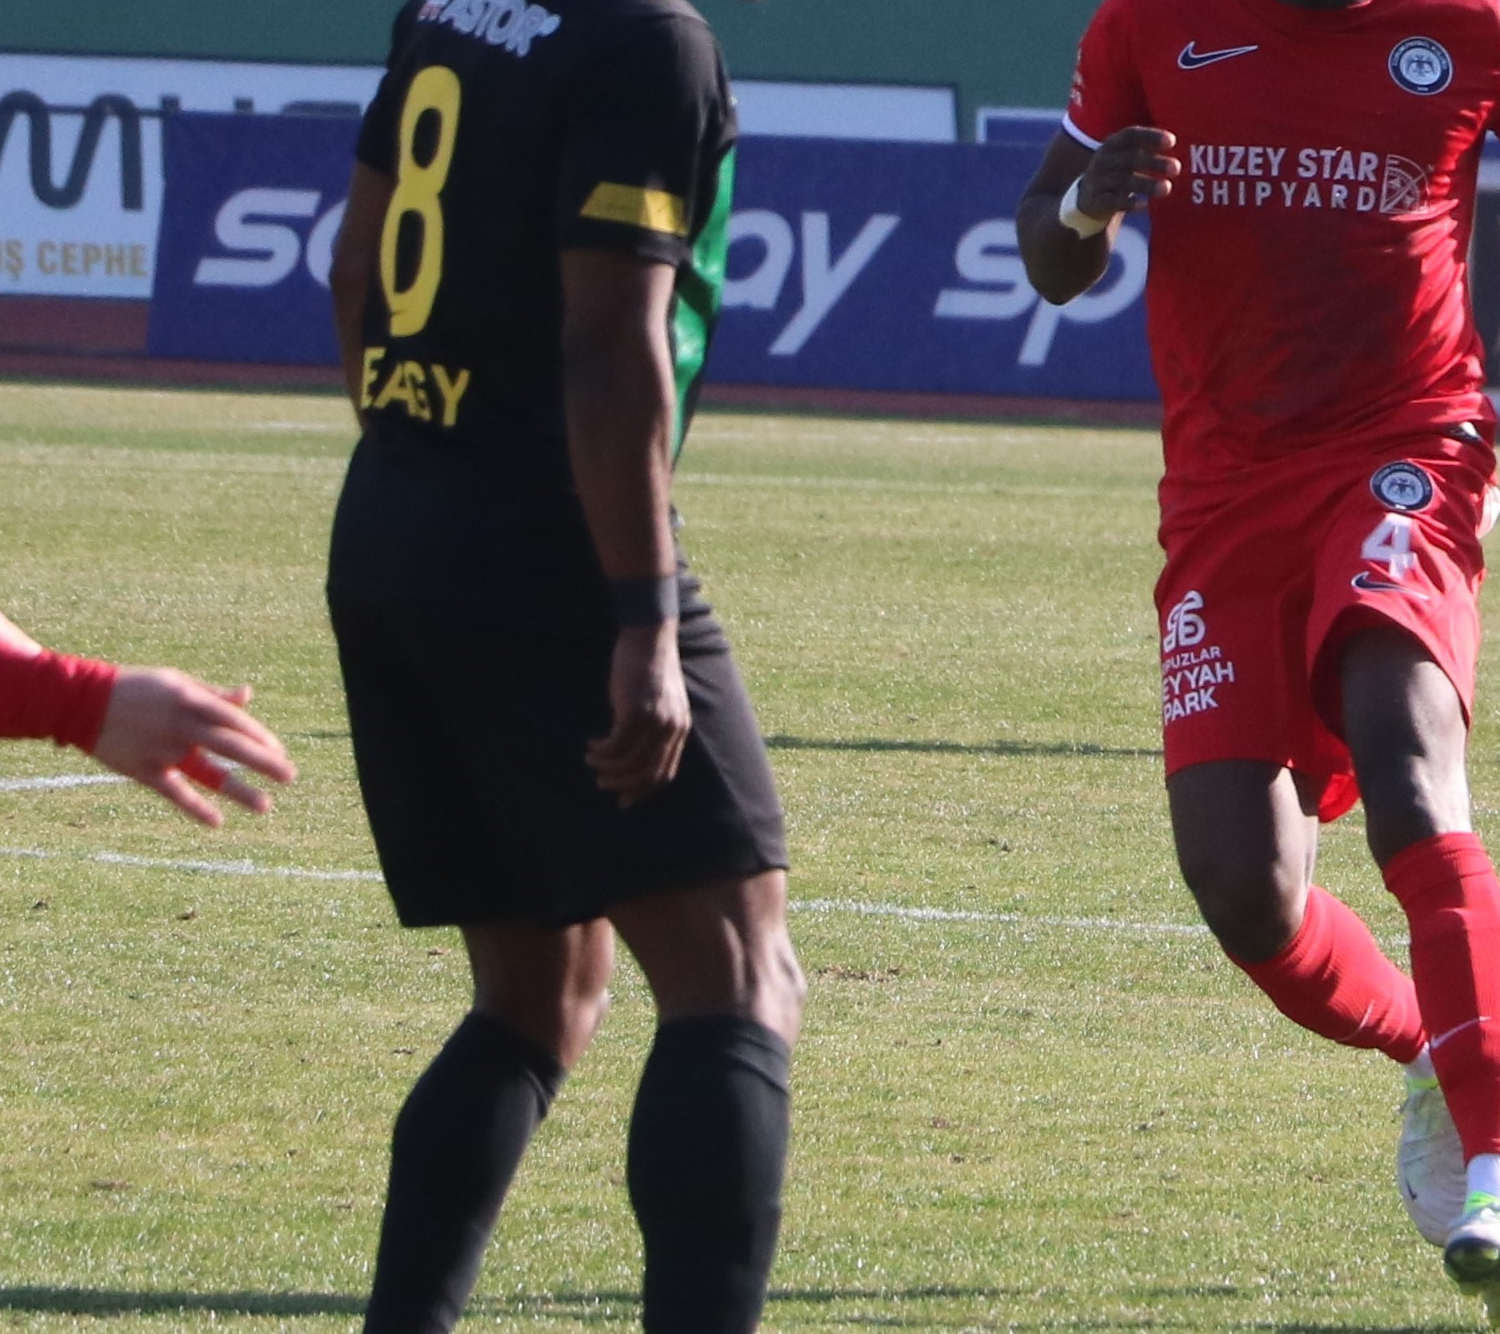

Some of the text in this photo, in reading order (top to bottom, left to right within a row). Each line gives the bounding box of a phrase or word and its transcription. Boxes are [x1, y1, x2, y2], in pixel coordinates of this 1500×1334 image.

[1190, 142, 1378, 183] KUZEY STAR
[379, 65, 462, 338] 8
[1190, 178, 1377, 213] SHIPYARD
[36, 241, 149, 278] CEPHE
[1360, 512, 1417, 579] 4
